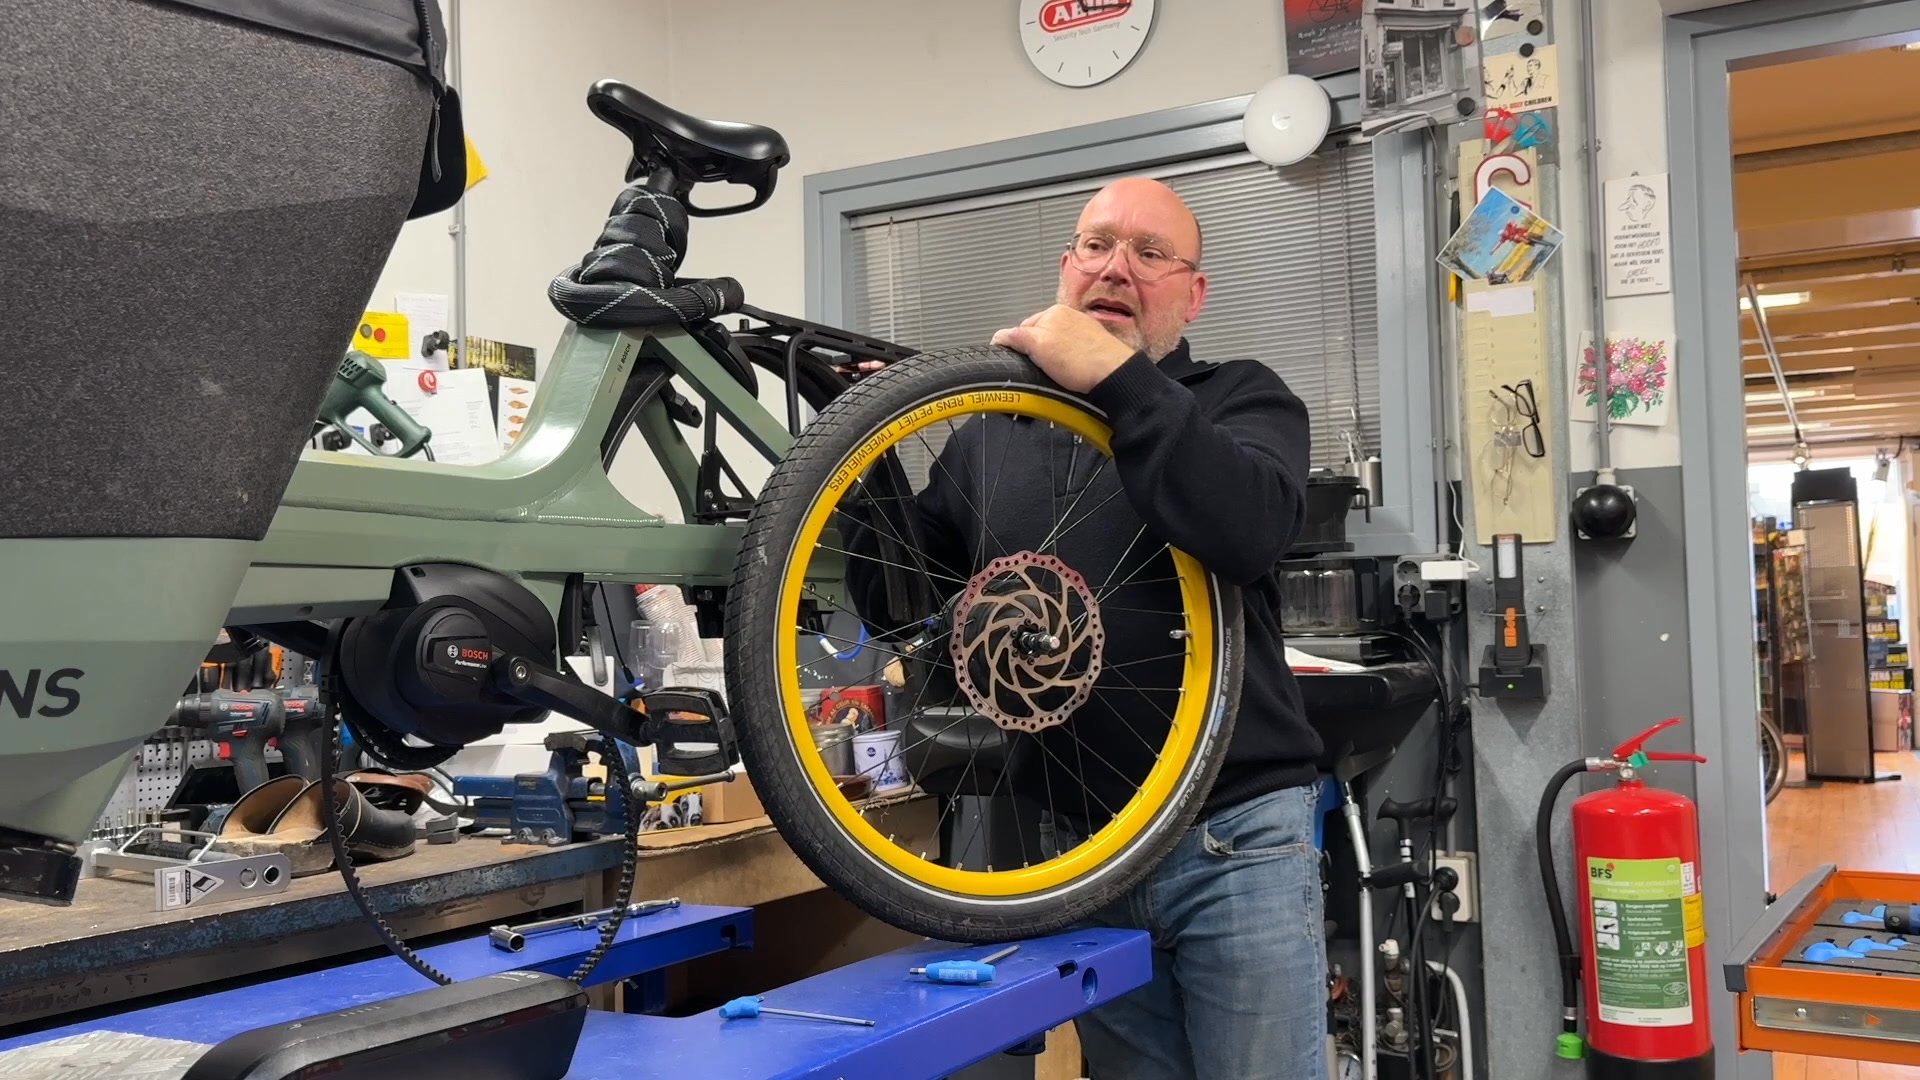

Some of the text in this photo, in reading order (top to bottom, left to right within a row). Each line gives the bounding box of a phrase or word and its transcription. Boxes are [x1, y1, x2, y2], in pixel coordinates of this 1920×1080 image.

[1053, 22, 1120, 42] Security Tech Germany
[620, 343, 632, 364] BOSCH
[936, 396, 965, 413] RENS
[461, 648, 489, 660] BOSCH
[1221, 627, 1232, 692] SCHWALBE
[0, 667, 85, 719] NS
[1179, 782, 1196, 809] PLUS
[1591, 867, 1612, 879] BFS
